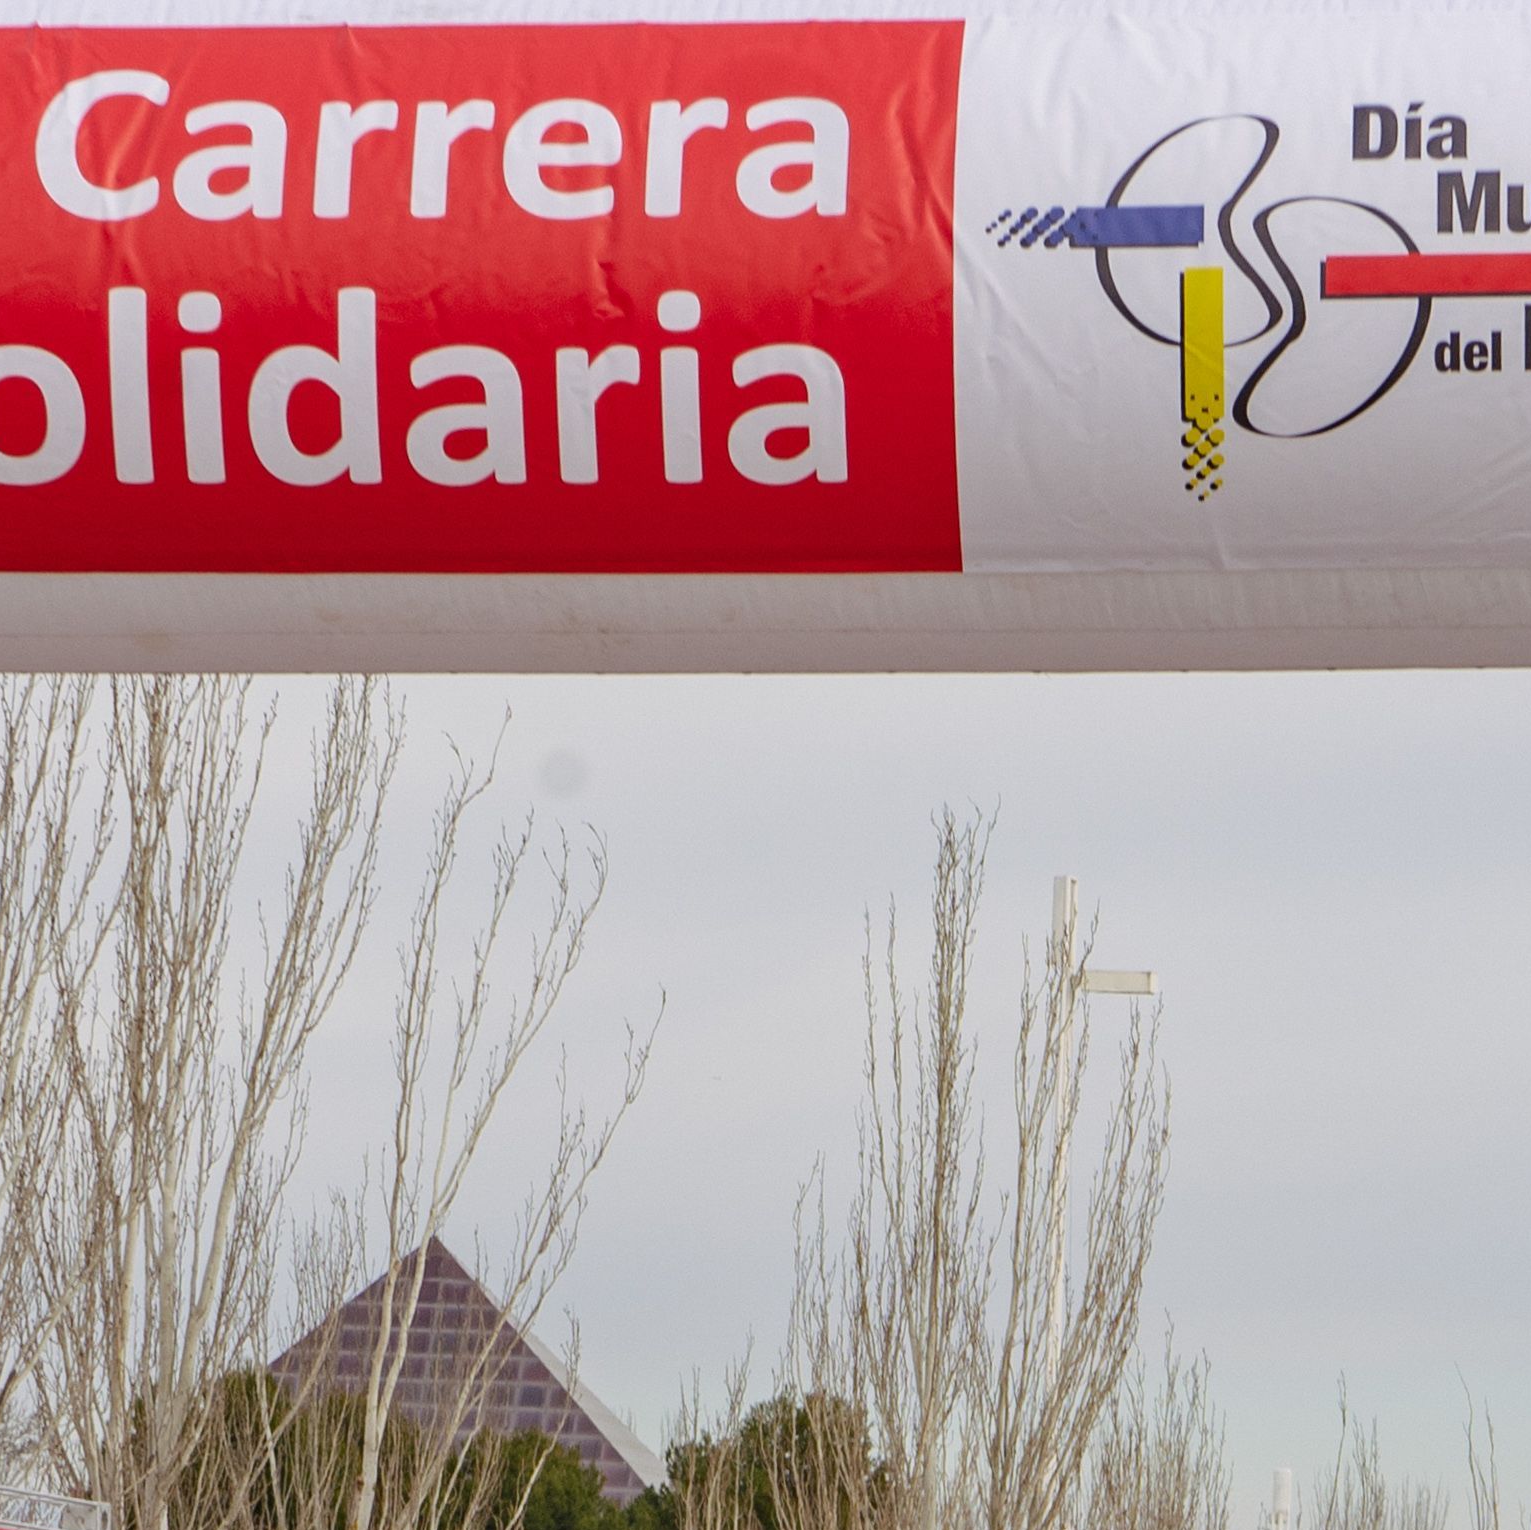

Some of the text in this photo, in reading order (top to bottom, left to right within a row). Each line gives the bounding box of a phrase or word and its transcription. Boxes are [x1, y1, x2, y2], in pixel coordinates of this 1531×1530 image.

[35, 69, 849, 221] Carrera
[1352, 102, 1468, 161] Día
[1434, 331, 1503, 373] del
